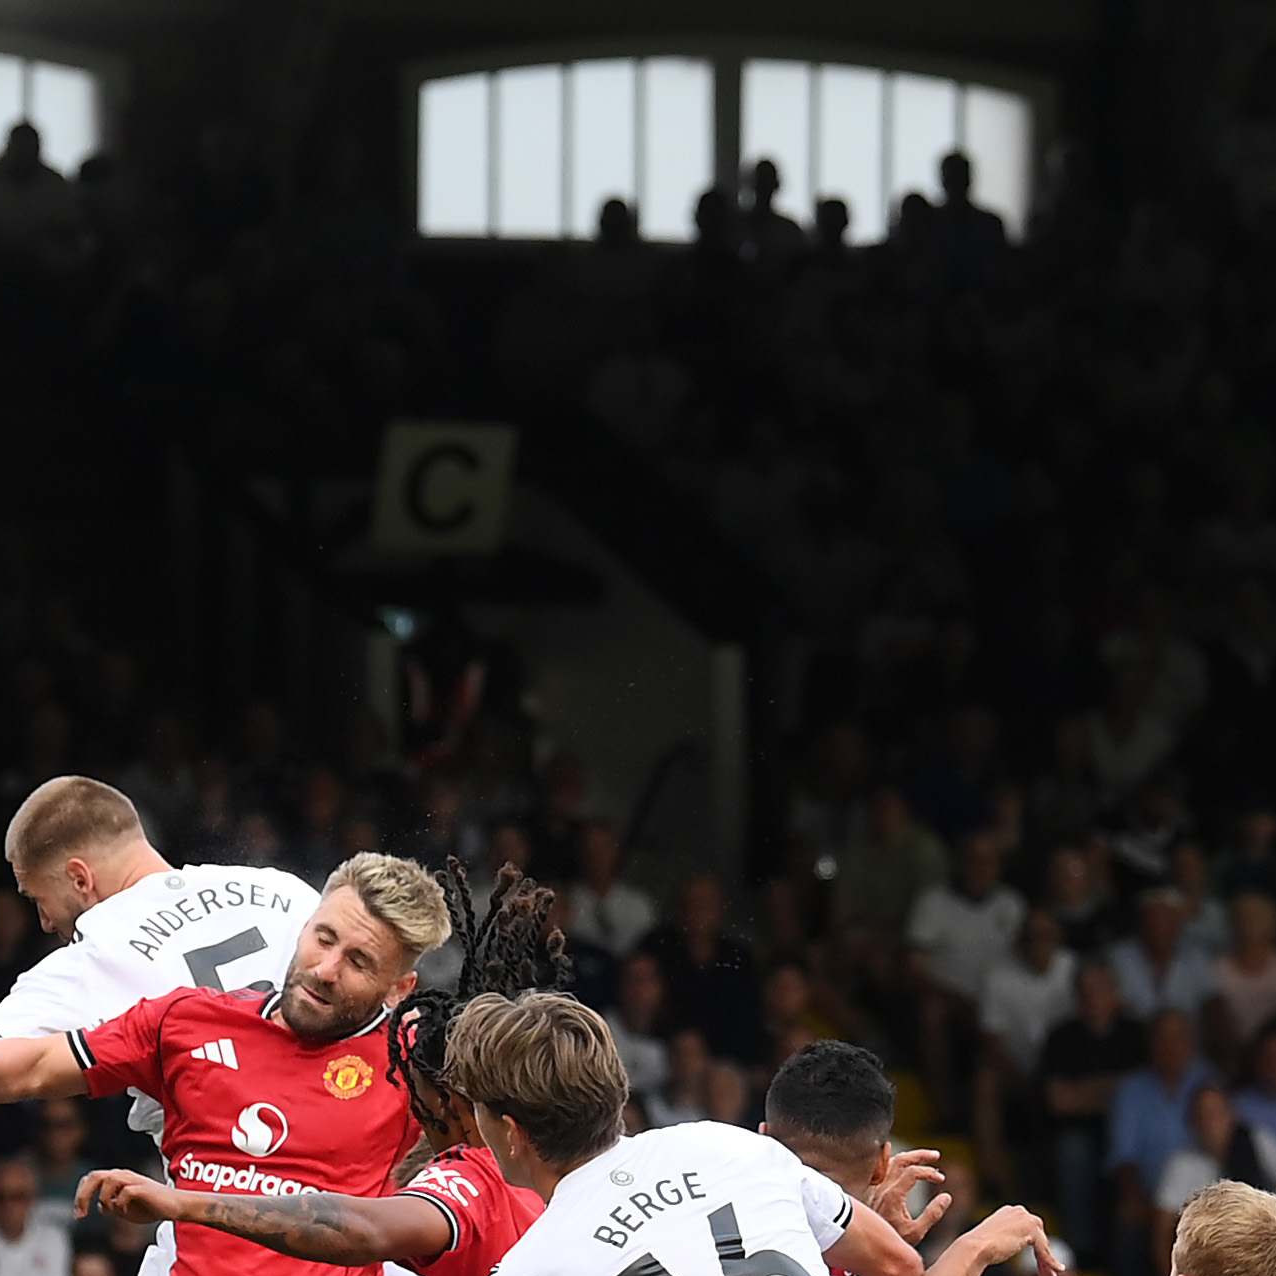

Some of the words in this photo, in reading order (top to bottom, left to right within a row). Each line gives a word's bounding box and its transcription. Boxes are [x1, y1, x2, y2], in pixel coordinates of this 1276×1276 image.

[403, 443, 480, 534] C
[129, 881, 292, 961] ANDERSEN
[179, 1153, 327, 1196] Snapdrag
[592, 1172, 707, 1249] BERGE
